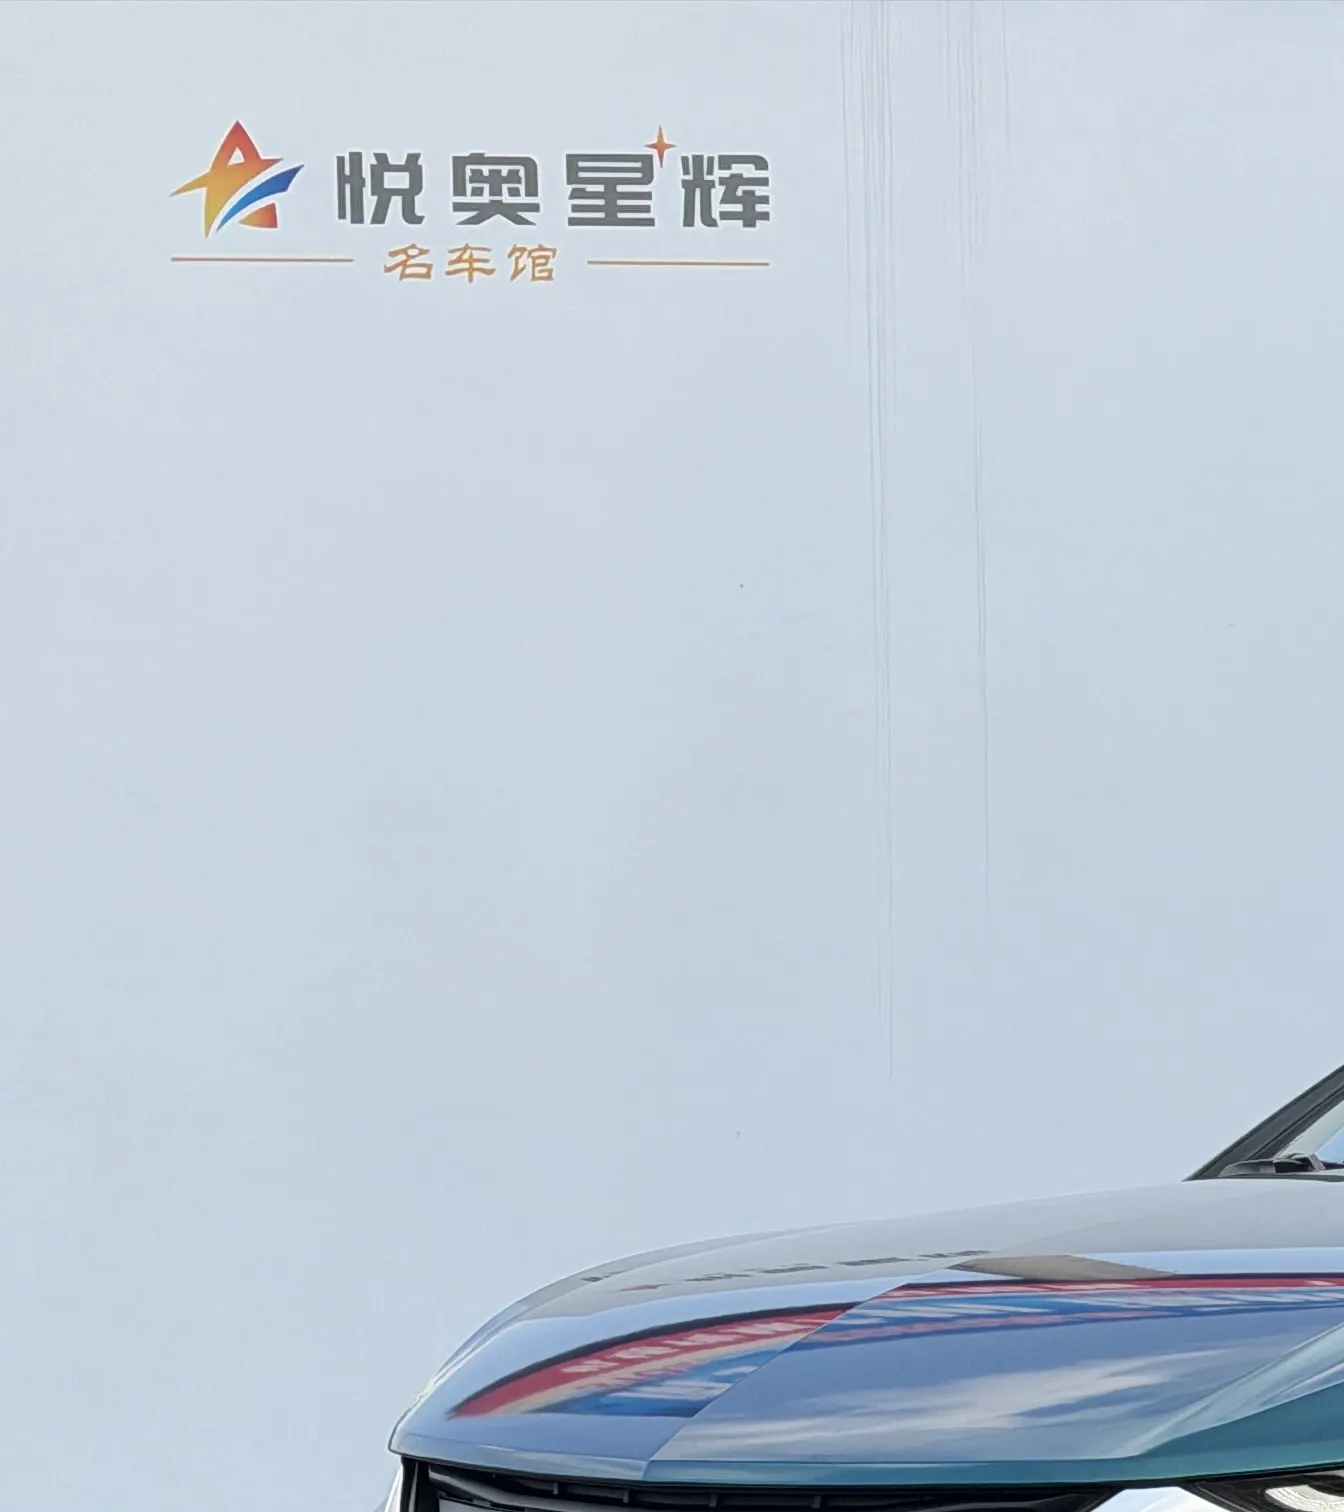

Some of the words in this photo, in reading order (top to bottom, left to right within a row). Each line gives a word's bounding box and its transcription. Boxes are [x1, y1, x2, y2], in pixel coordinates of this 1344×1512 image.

[336, 151, 771, 228] 悦奥星辉
[383, 244, 558, 284] 名车馆
